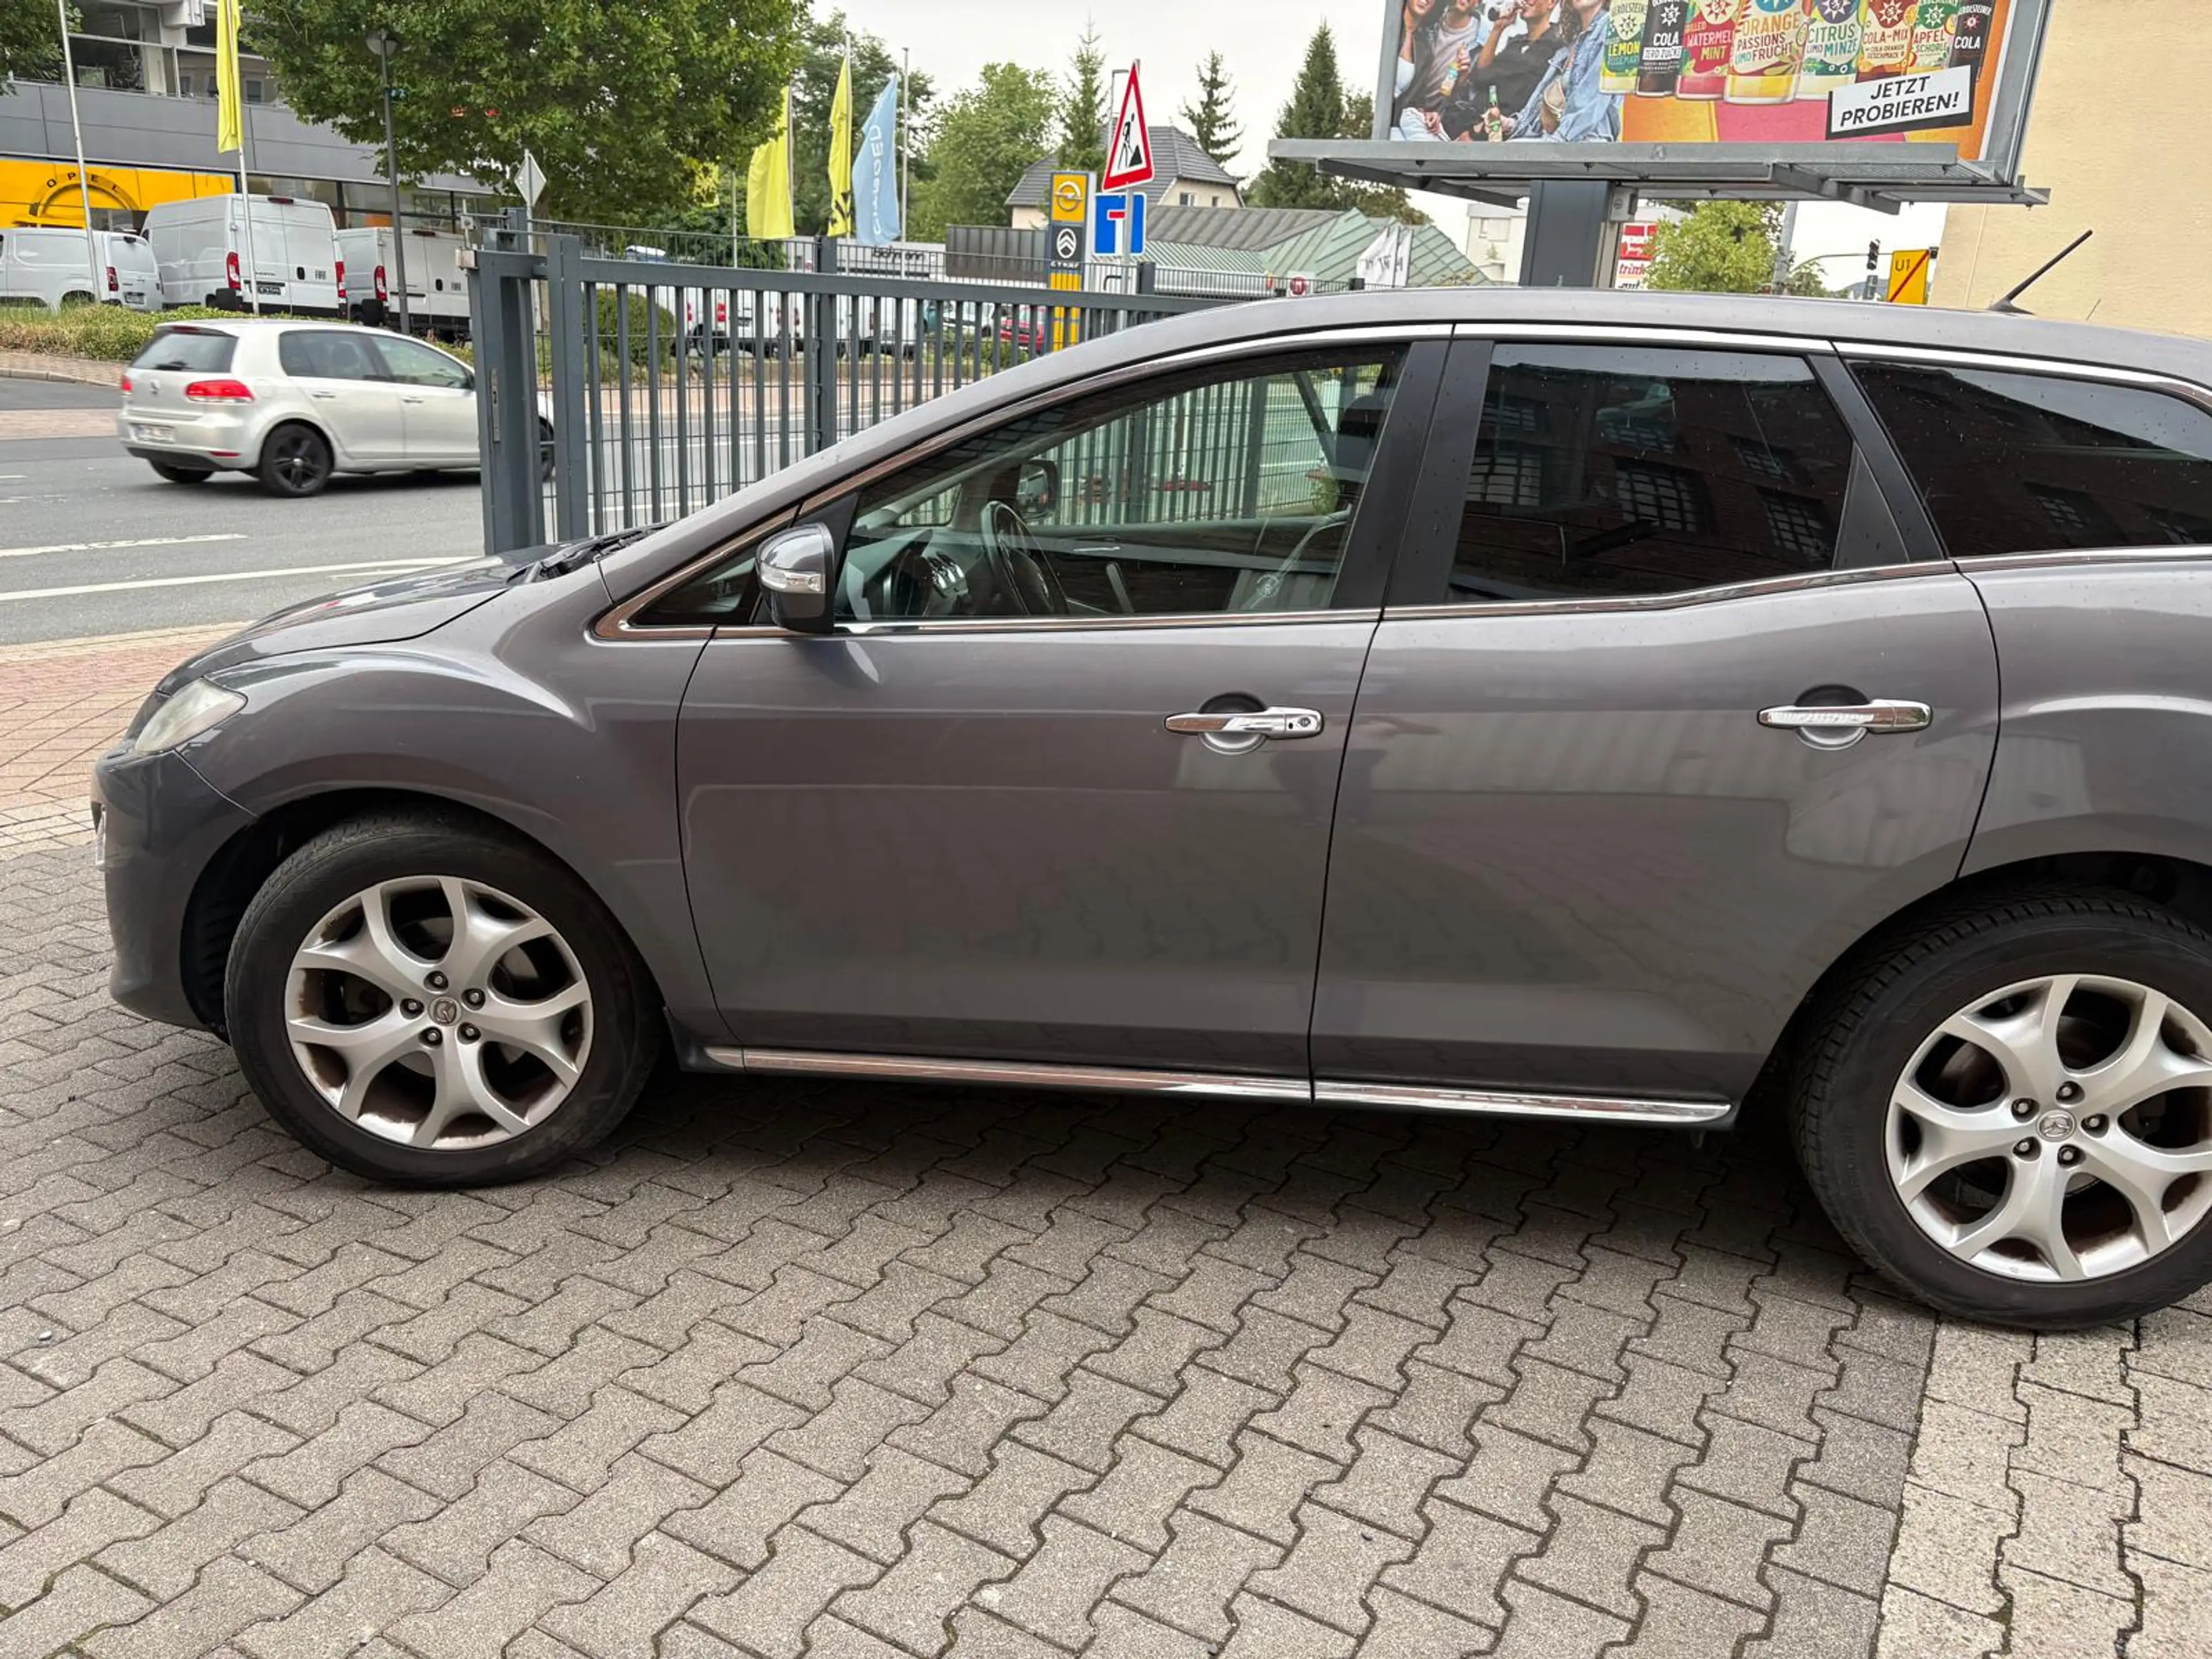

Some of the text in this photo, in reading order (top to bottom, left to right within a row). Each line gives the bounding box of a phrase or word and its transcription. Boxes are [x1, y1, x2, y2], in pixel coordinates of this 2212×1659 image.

[1743, 11, 1800, 36] ORANGE
[1808, 23, 1856, 44] CITRUS
[1653, 32, 1680, 46] COLA
[1737, 32, 1786, 50] PASSIONS
[1913, 29, 1945, 44] APFEL
[1955, 36, 1980, 49] COLA
[1609, 41, 1641, 56] LEMON
[1700, 46, 1726, 60] MINT
[1752, 41, 1793, 62] FRUCHT
[1824, 37, 1857, 57] MINZE
[1870, 75, 1931, 100] JETZT
[1840, 91, 1960, 127] PROBIEREN!
[47, 171, 121, 194] OPEL
